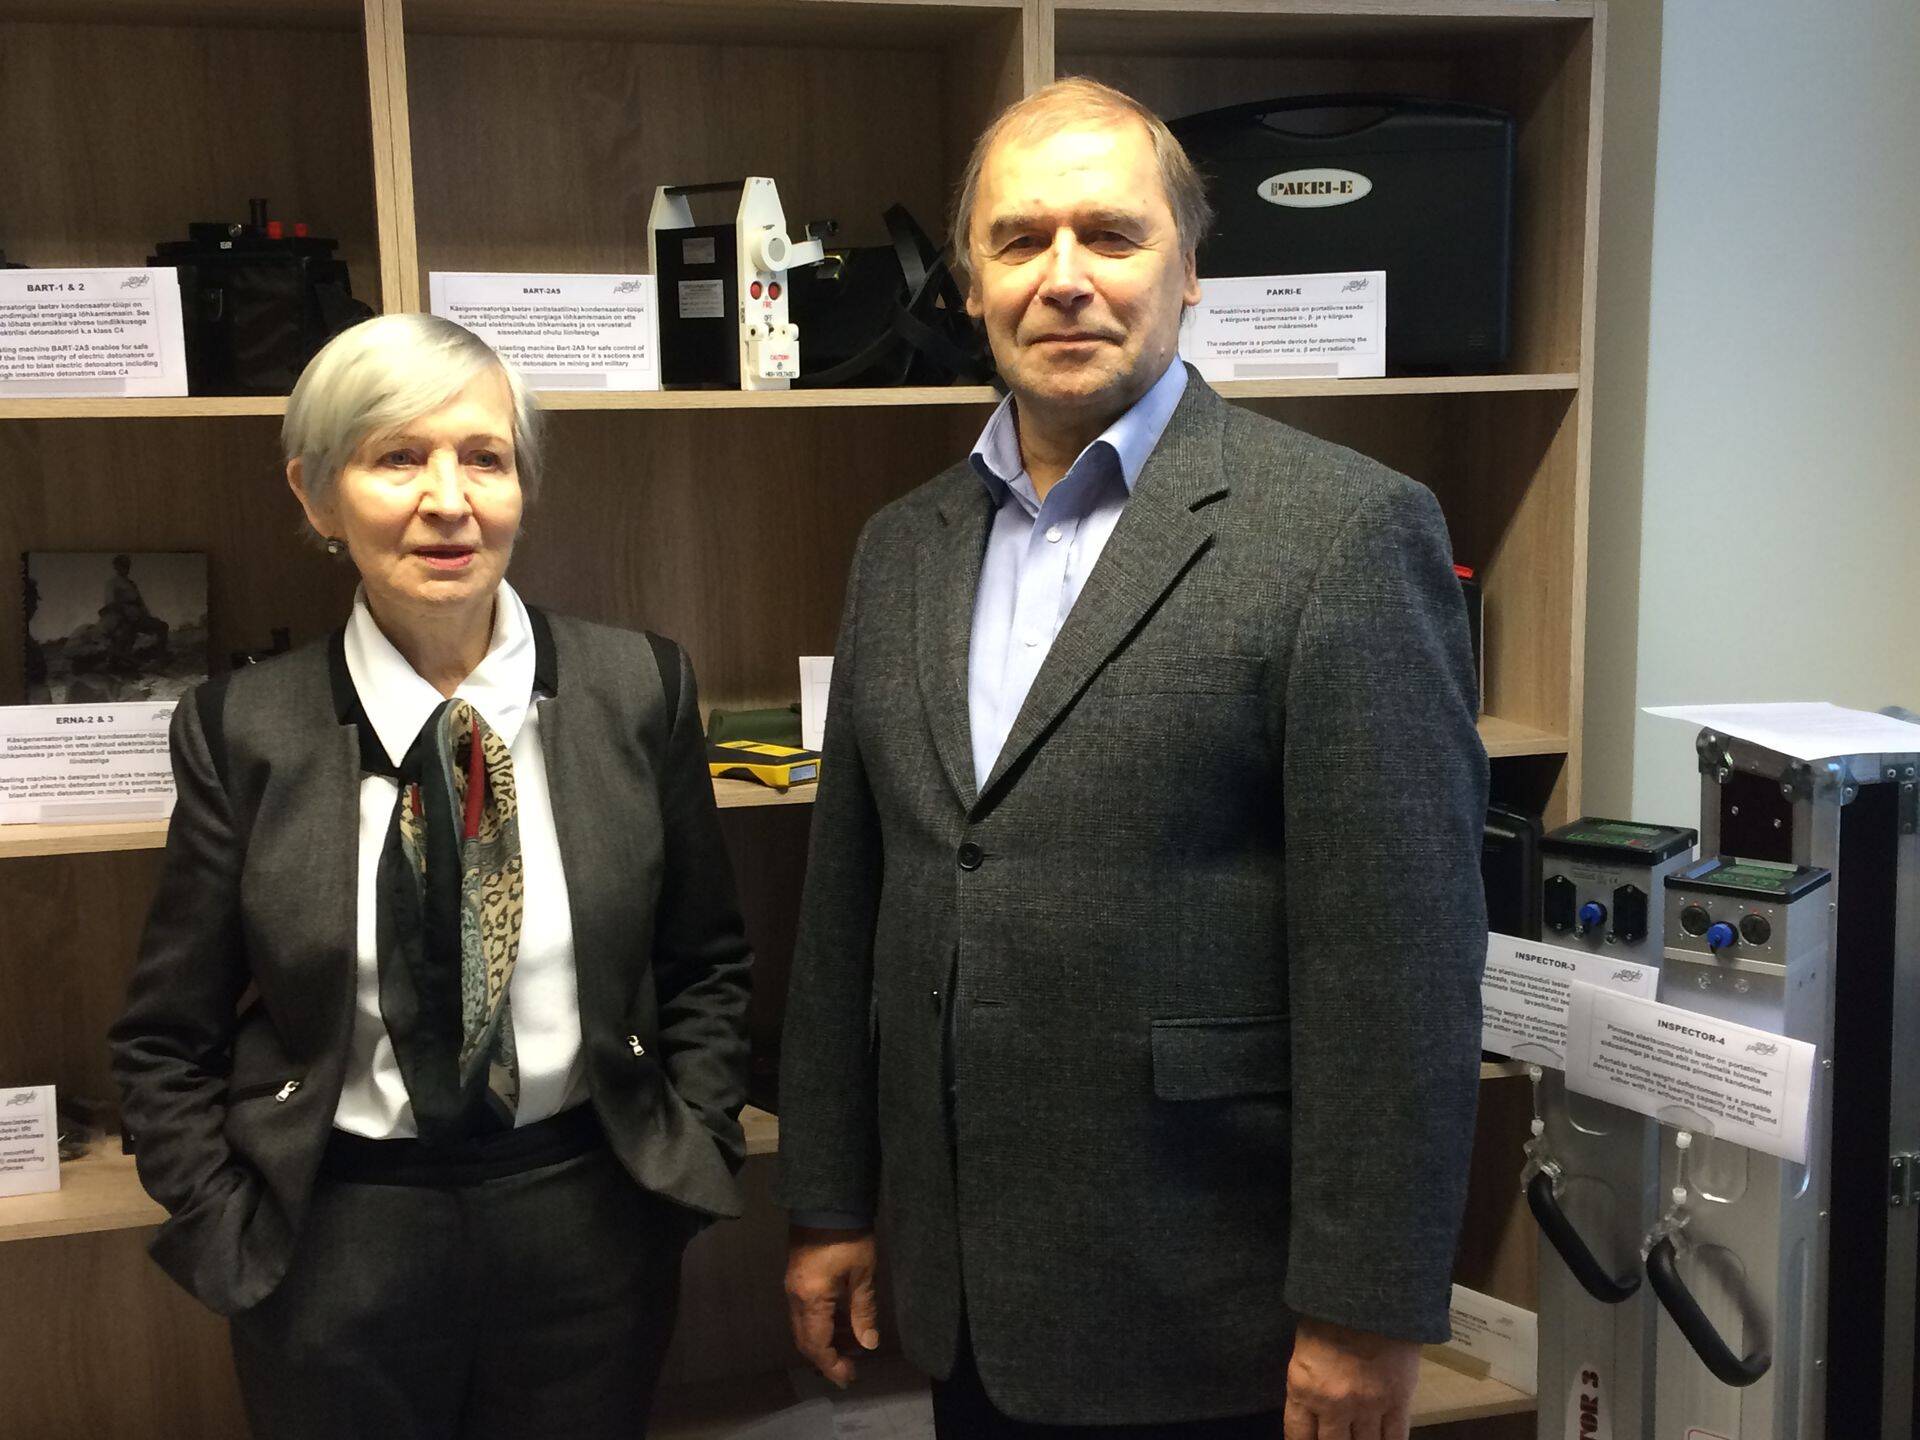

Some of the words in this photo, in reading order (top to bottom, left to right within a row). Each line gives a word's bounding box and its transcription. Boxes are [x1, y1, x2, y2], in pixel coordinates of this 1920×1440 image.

[1271, 181, 1353, 196] PAKRI-E
[27, 284, 64, 292] BART-1
[78, 283, 85, 291] 2
[1266, 288, 1302, 296] PAKRI-E
[56, 716, 94, 725] ERNA-2
[107, 715, 115, 723] 3
[1514, 951, 1577, 972] INSPECTOR-3
[1657, 1018, 1725, 1046] INSPECTOR-4
[1581, 1370, 1599, 1389] 3
